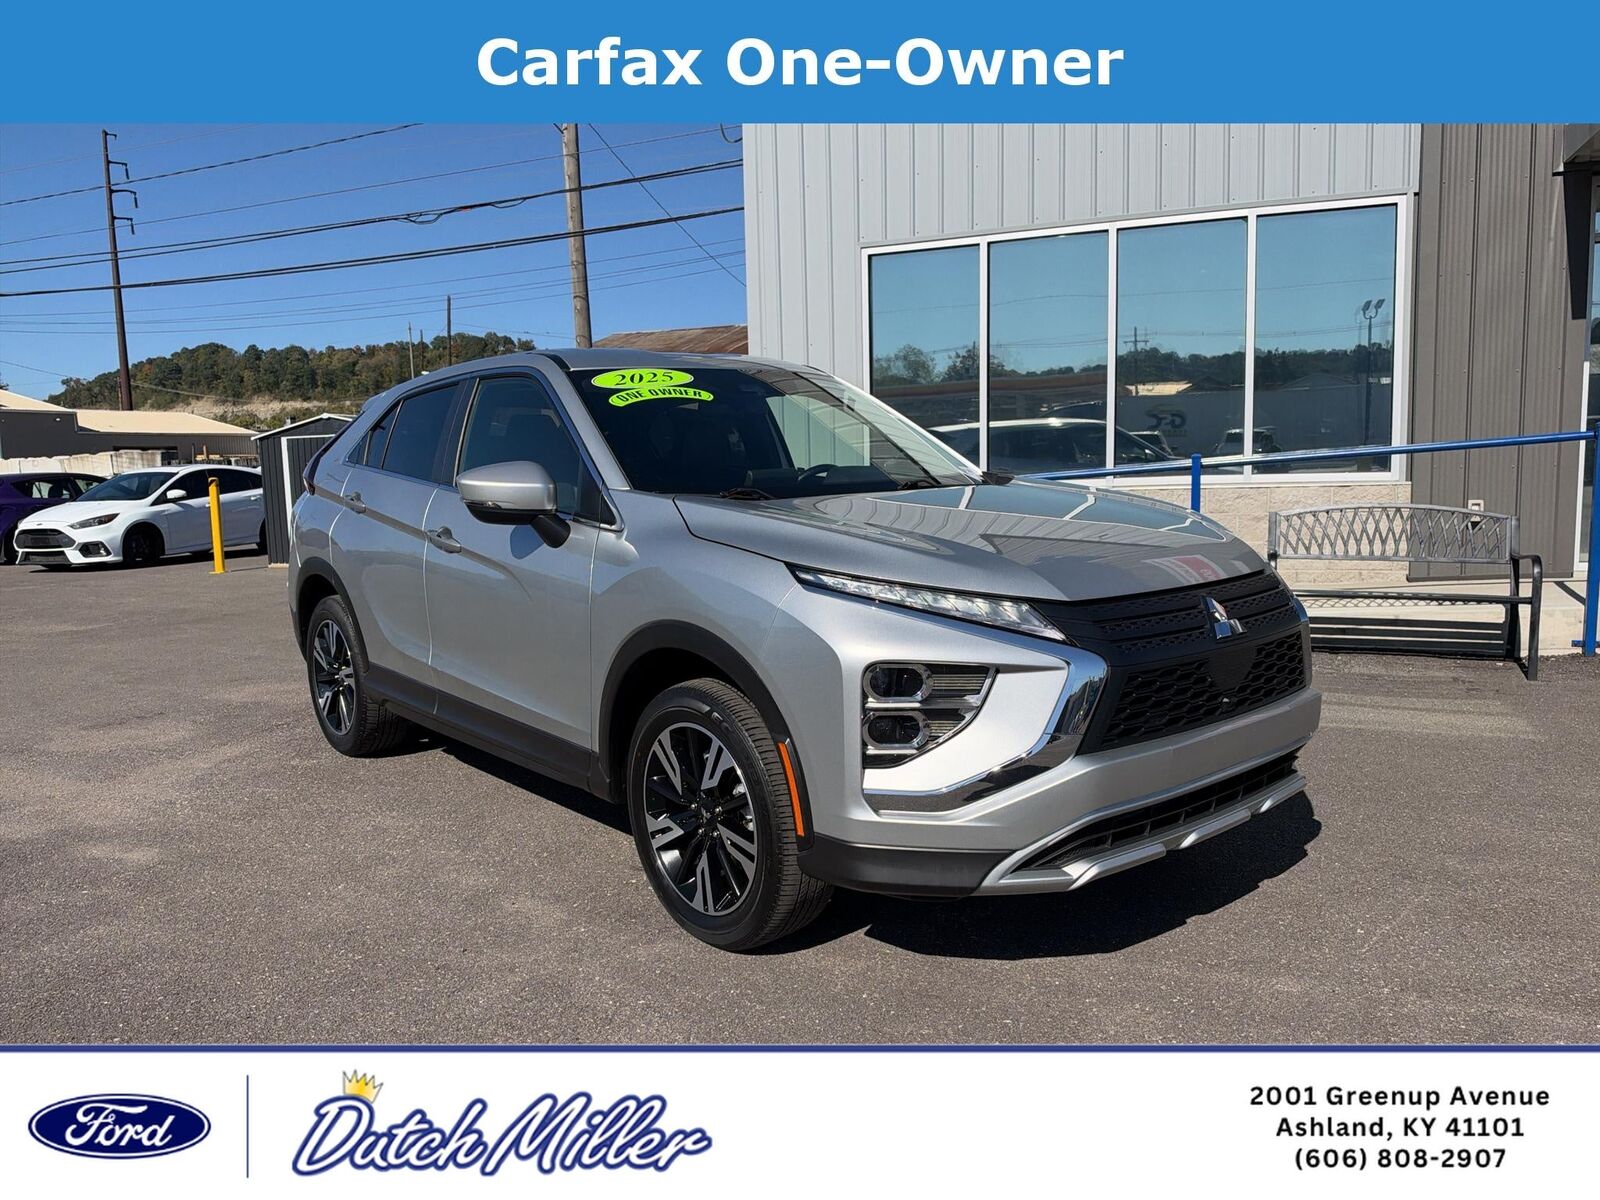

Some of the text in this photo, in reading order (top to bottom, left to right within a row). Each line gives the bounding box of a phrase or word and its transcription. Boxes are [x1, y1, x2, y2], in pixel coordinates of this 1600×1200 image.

[614, 371, 674, 386] 2025
[616, 388, 703, 402] ONE OWNER
